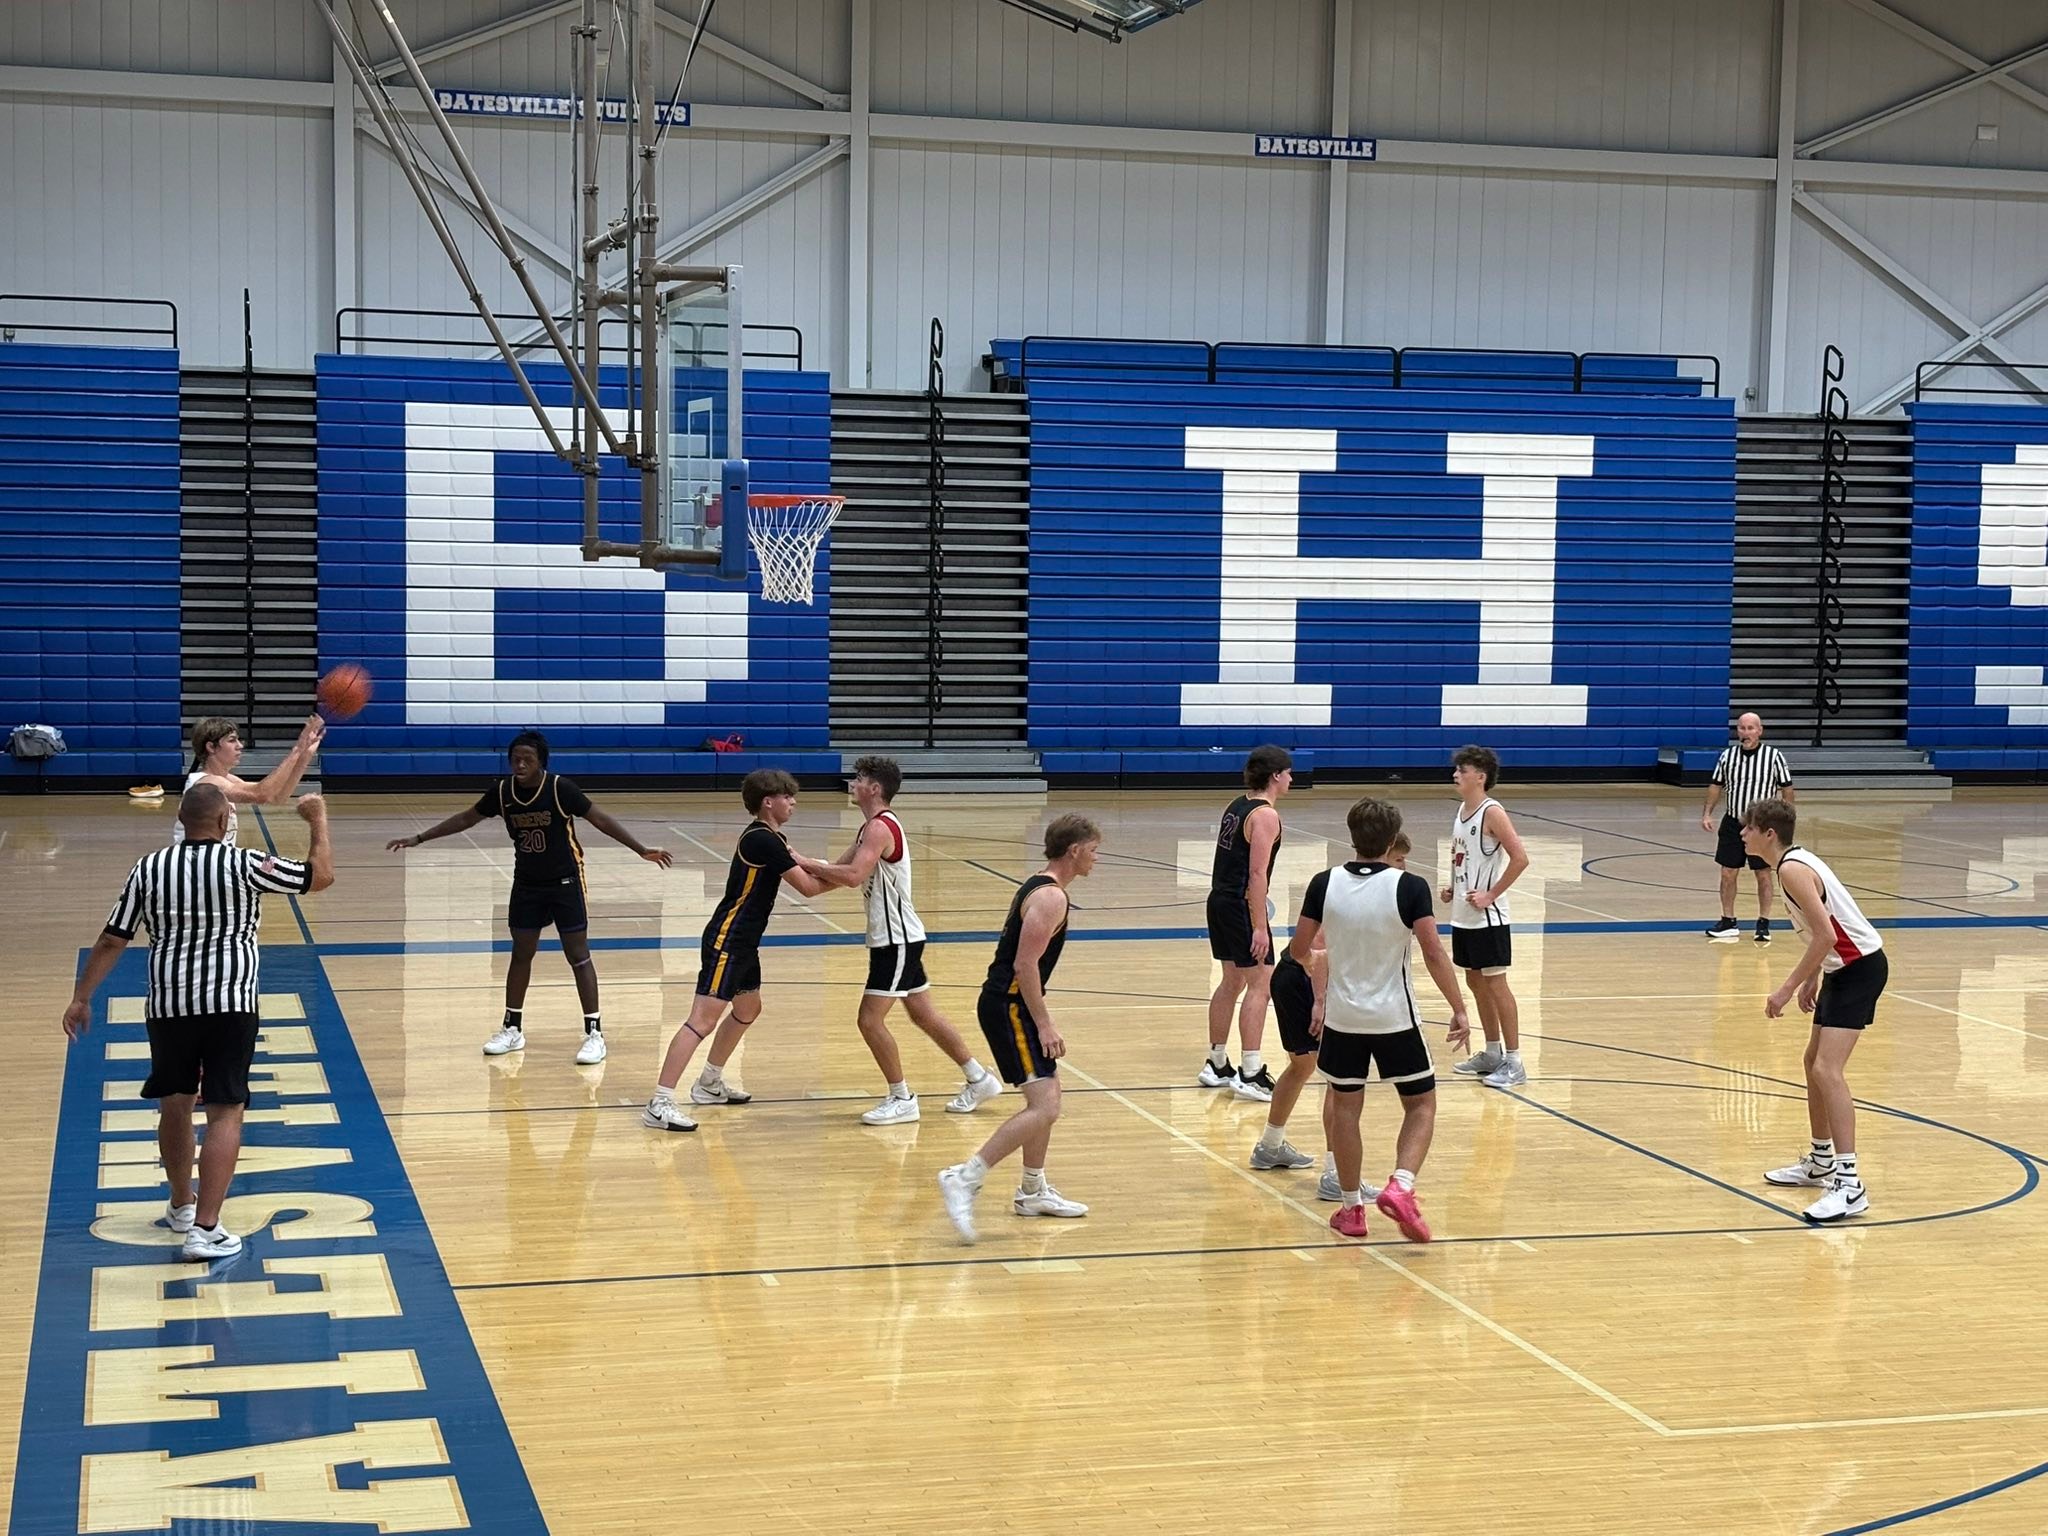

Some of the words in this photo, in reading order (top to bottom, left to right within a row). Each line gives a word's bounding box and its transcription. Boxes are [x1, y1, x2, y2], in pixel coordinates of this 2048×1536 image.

[439, 92, 571, 116] BATESVILLE
[1258, 137, 1373, 158] BATESVILLE
[1180, 426, 1595, 726] H
[518, 829, 547, 853] 20
[1470, 825, 1477, 836] 8
